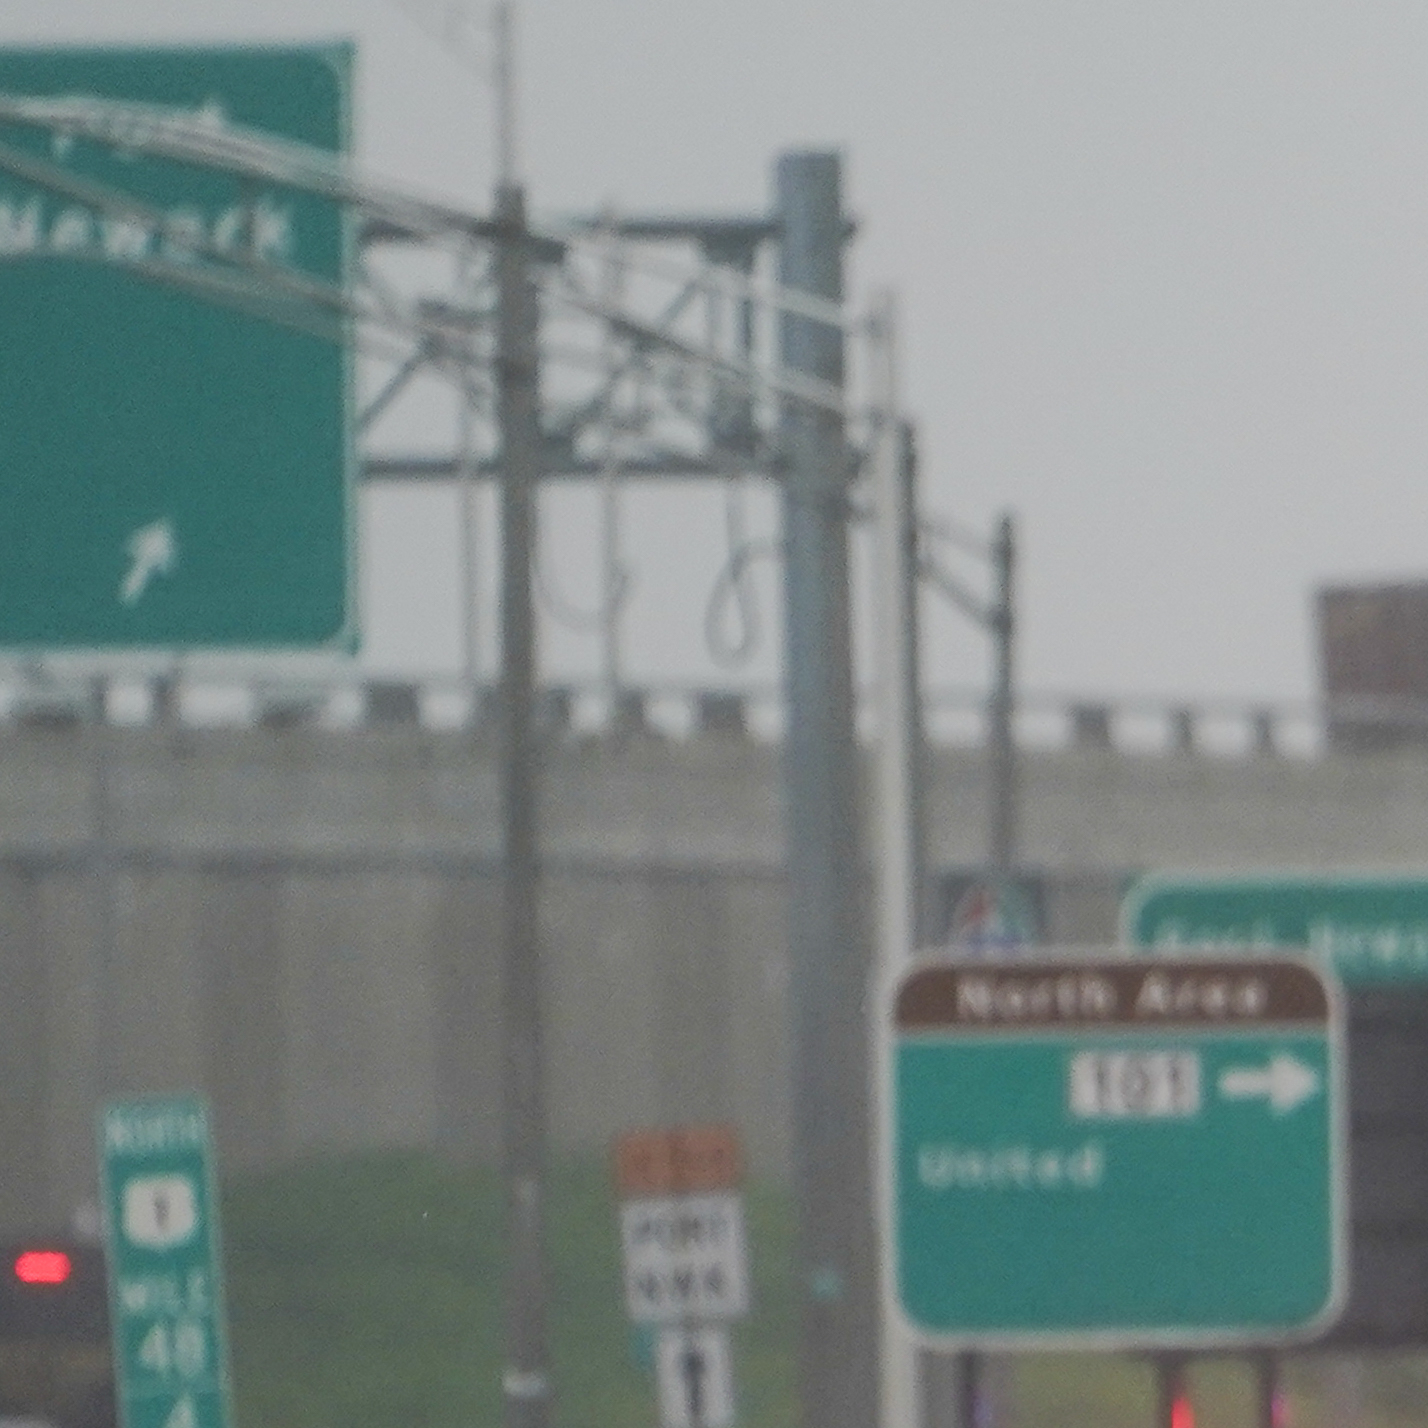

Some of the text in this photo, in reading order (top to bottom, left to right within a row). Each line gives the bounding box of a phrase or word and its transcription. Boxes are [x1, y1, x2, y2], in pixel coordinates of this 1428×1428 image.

[954, 968, 1270, 1020] North Area
[1091, 1054, 1184, 1116] 101
[916, 1141, 1106, 1188] United
